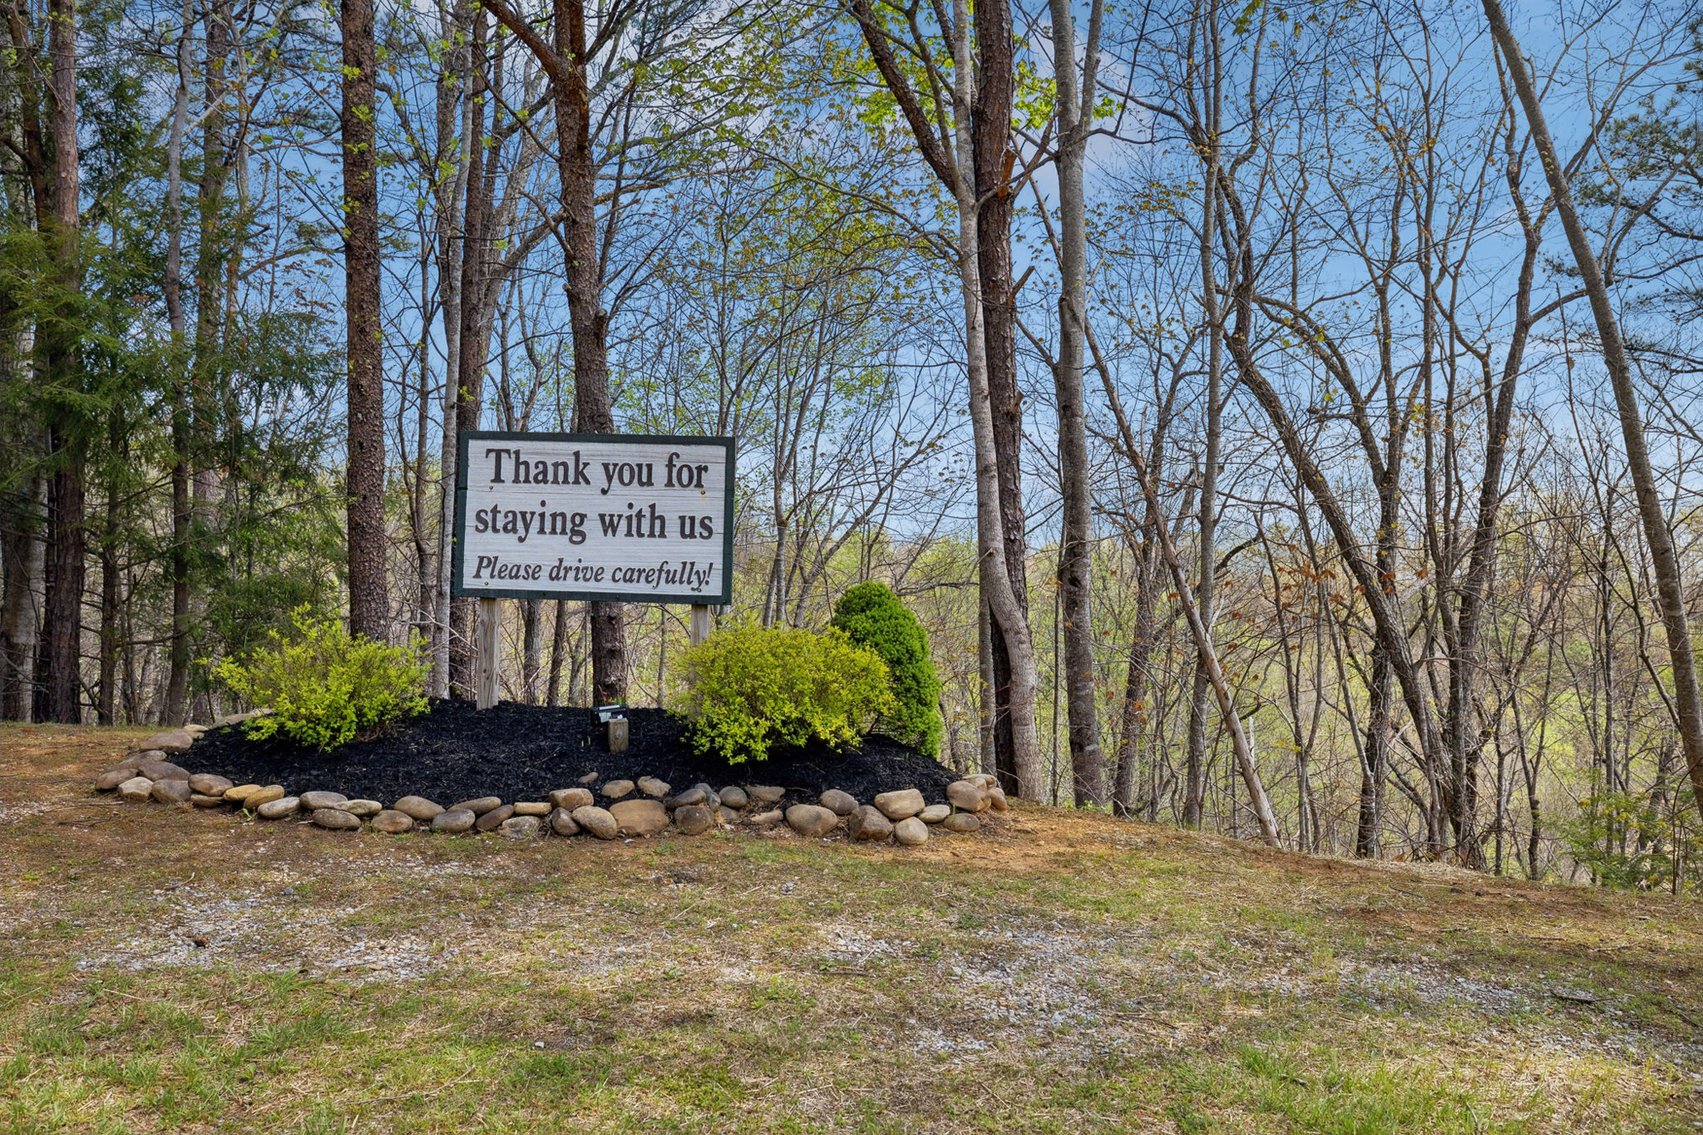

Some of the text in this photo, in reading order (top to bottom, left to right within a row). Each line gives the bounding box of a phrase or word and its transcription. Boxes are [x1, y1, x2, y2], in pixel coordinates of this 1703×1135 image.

[485, 448, 709, 496] Thank you for
[474, 499, 714, 546] staying with us
[472, 555, 714, 593] Please drive carefully!
